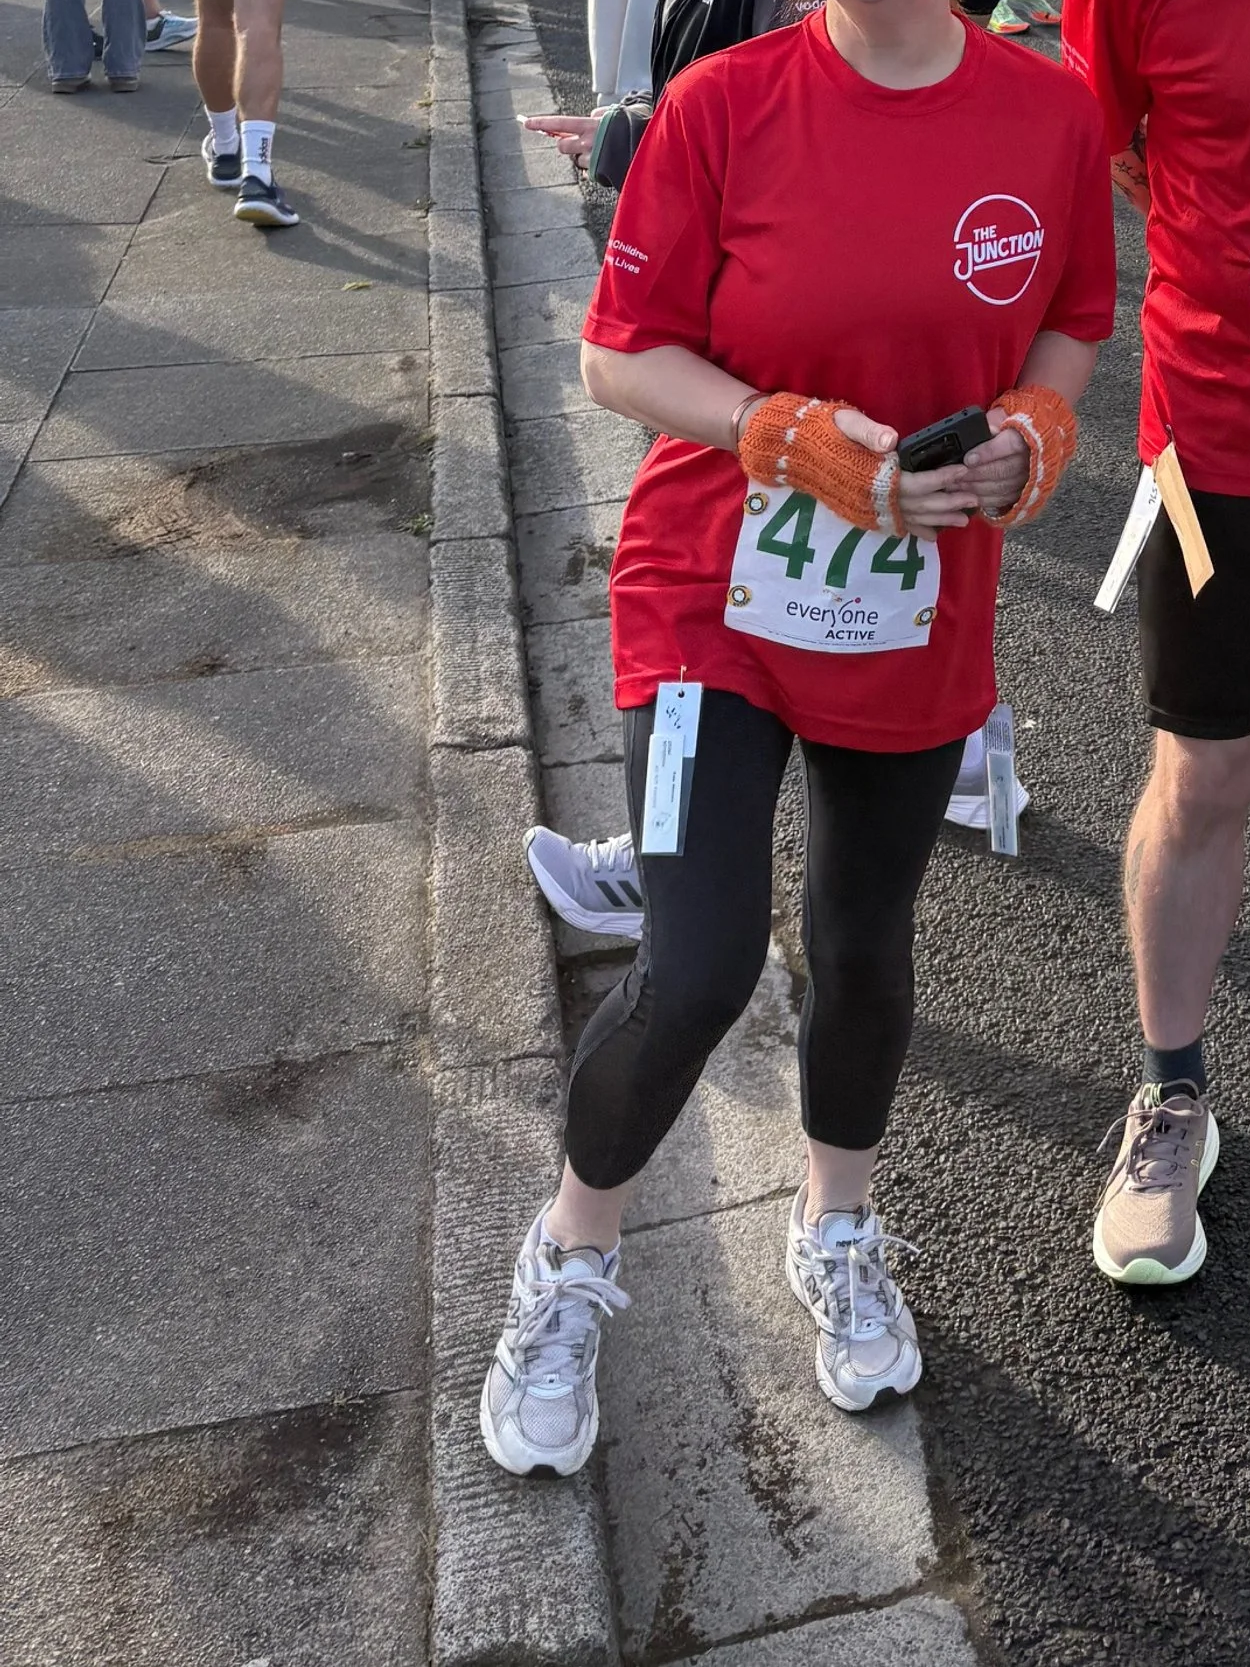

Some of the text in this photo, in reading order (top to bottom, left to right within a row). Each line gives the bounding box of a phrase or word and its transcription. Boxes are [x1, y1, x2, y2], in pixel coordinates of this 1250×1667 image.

[973, 224, 997, 243] THE
[612, 239, 649, 263] Children
[953, 228, 1045, 281] JUNCTION
[614, 256, 641, 274] Lives
[786, 597, 879, 628] everyone
[824, 629, 876, 641] ACTIVE
